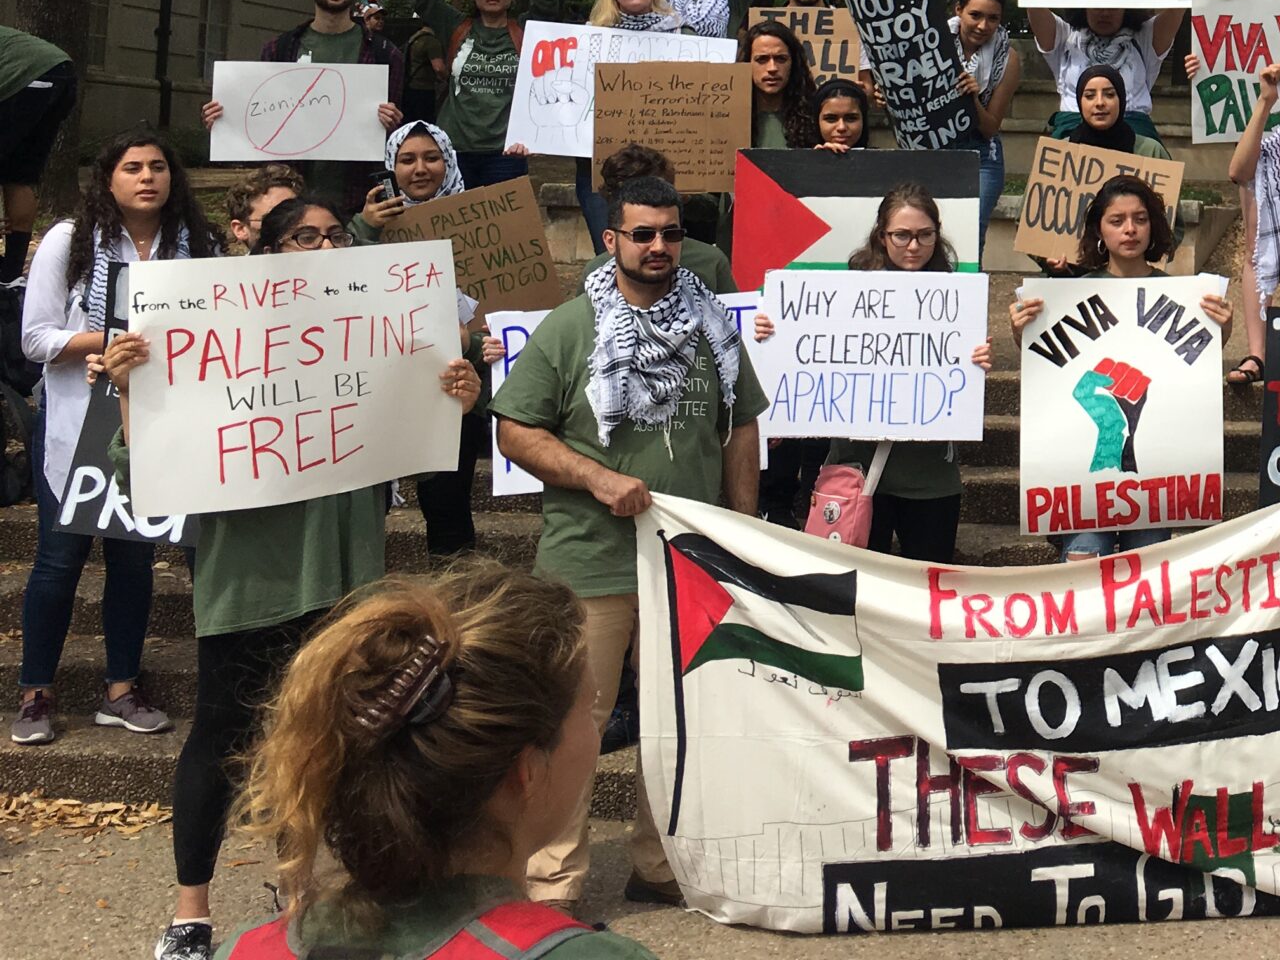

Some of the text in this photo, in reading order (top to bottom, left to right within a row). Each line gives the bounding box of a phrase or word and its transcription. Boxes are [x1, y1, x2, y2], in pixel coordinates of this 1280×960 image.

[856, 0, 930, 44] NJOY
[531, 36, 579, 79] one
[873, 41, 910, 62] TRIP
[912, 27, 940, 53] TO
[1192, 15, 1275, 74] VIVA
[598, 69, 735, 92] Who is the real
[901, 116, 930, 133] ARE
[1038, 146, 1105, 186] END
[430, 190, 524, 237] PALESTINE
[481, 238, 544, 271] WALLS
[132, 290, 170, 315] from
[179, 295, 207, 311] the
[213, 277, 316, 311] RIVER
[323, 284, 341, 297] to
[348, 281, 369, 294] the
[383, 261, 444, 293] SEA
[490, 262, 548, 298] TO GO
[780, 279, 959, 323] WHY ARE YOU
[165, 303, 436, 386] PALESTINE
[795, 330, 962, 368] CELEBRATING
[1028, 293, 1120, 369] VIVA
[1136, 287, 1214, 367] VIVA
[225, 370, 373, 412] WILL BE
[769, 367, 967, 426] APARTHEID?
[217, 402, 365, 486] FREE
[673, 421, 687, 431] TX
[1026, 473, 1223, 534] PALESTINA
[928, 566, 1079, 640] FROM
[960, 668, 1082, 740] TO
[848, 733, 1102, 853] THESE
